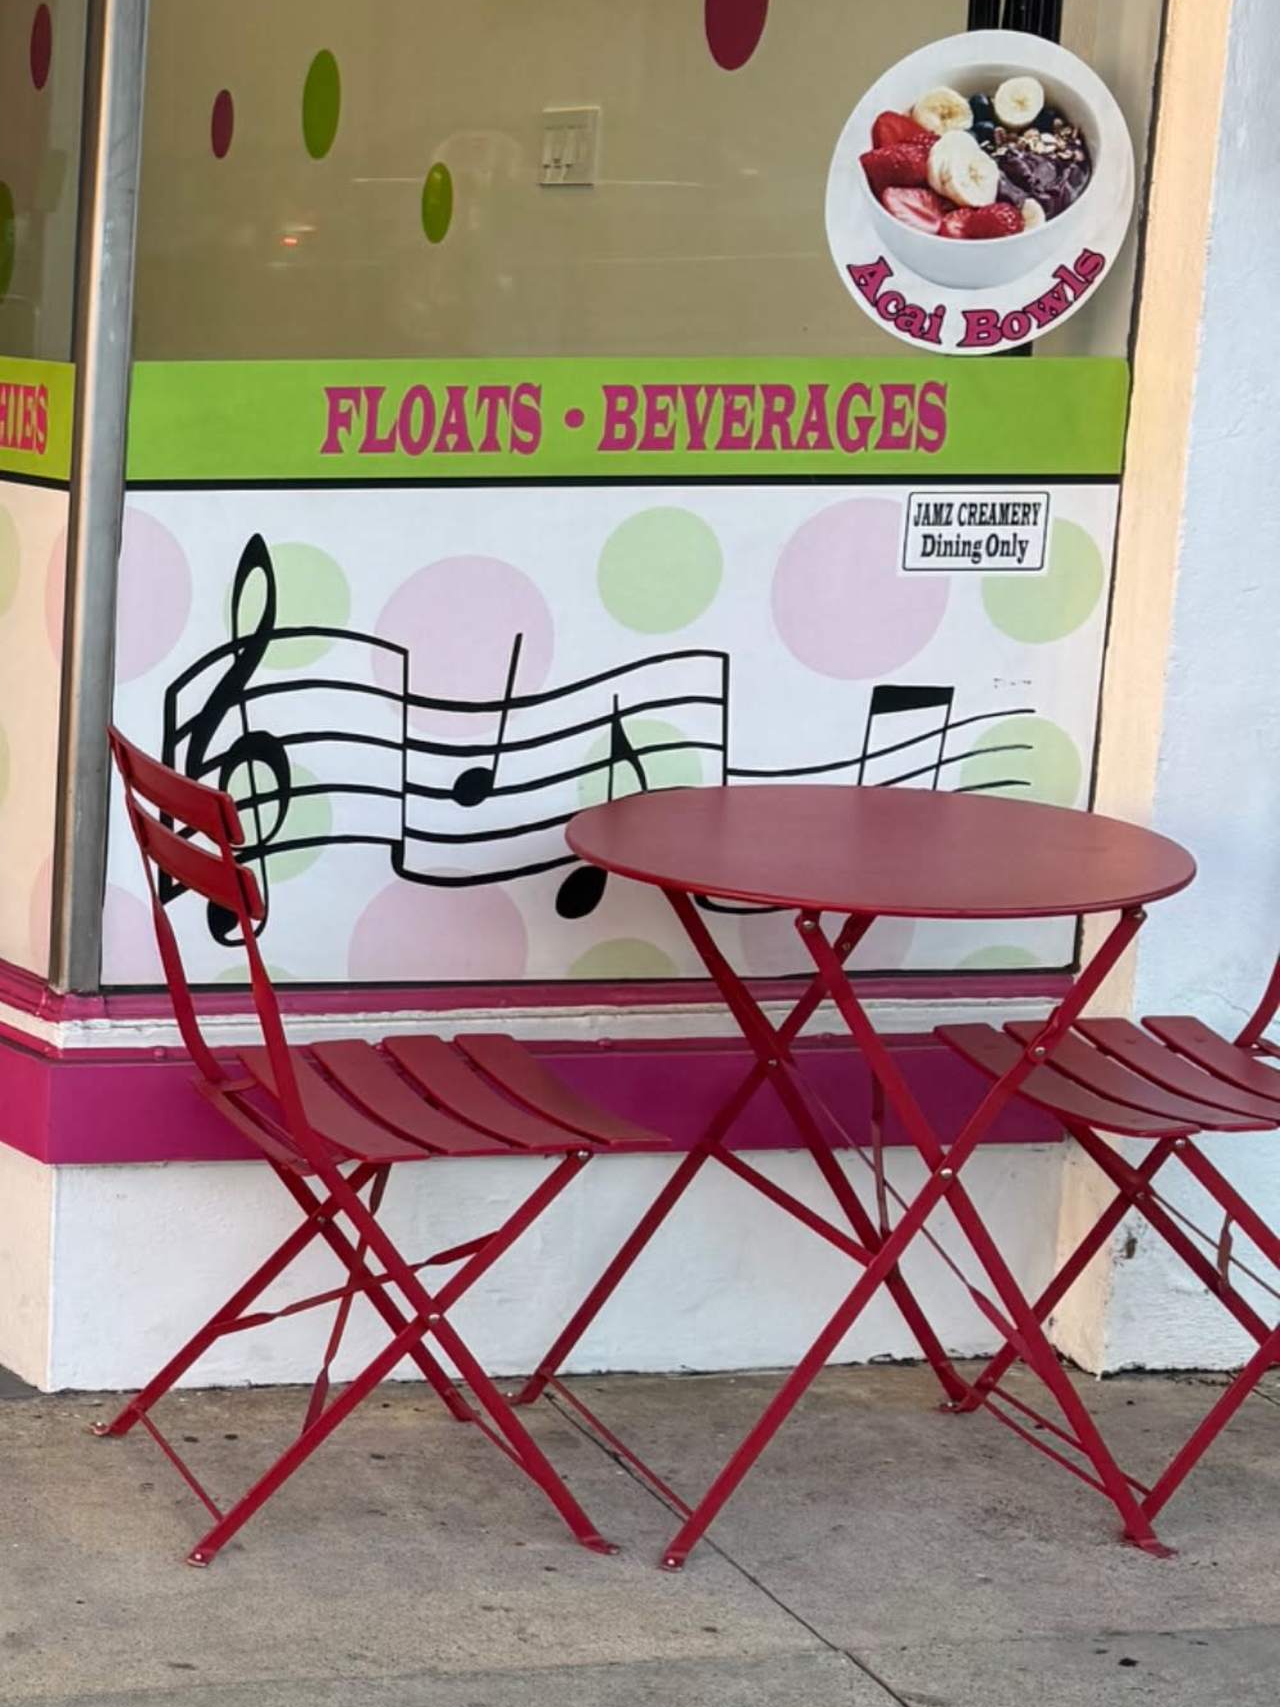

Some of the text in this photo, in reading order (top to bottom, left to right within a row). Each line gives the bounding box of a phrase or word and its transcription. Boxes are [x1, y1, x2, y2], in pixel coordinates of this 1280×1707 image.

[846, 248, 1106, 347] Acai Bowls
[320, 382, 949, 456] FLOATS BEVERAGES
[913, 502, 1042, 527] JAMZ CREAMERY
[920, 532, 1029, 564] Dining Only
